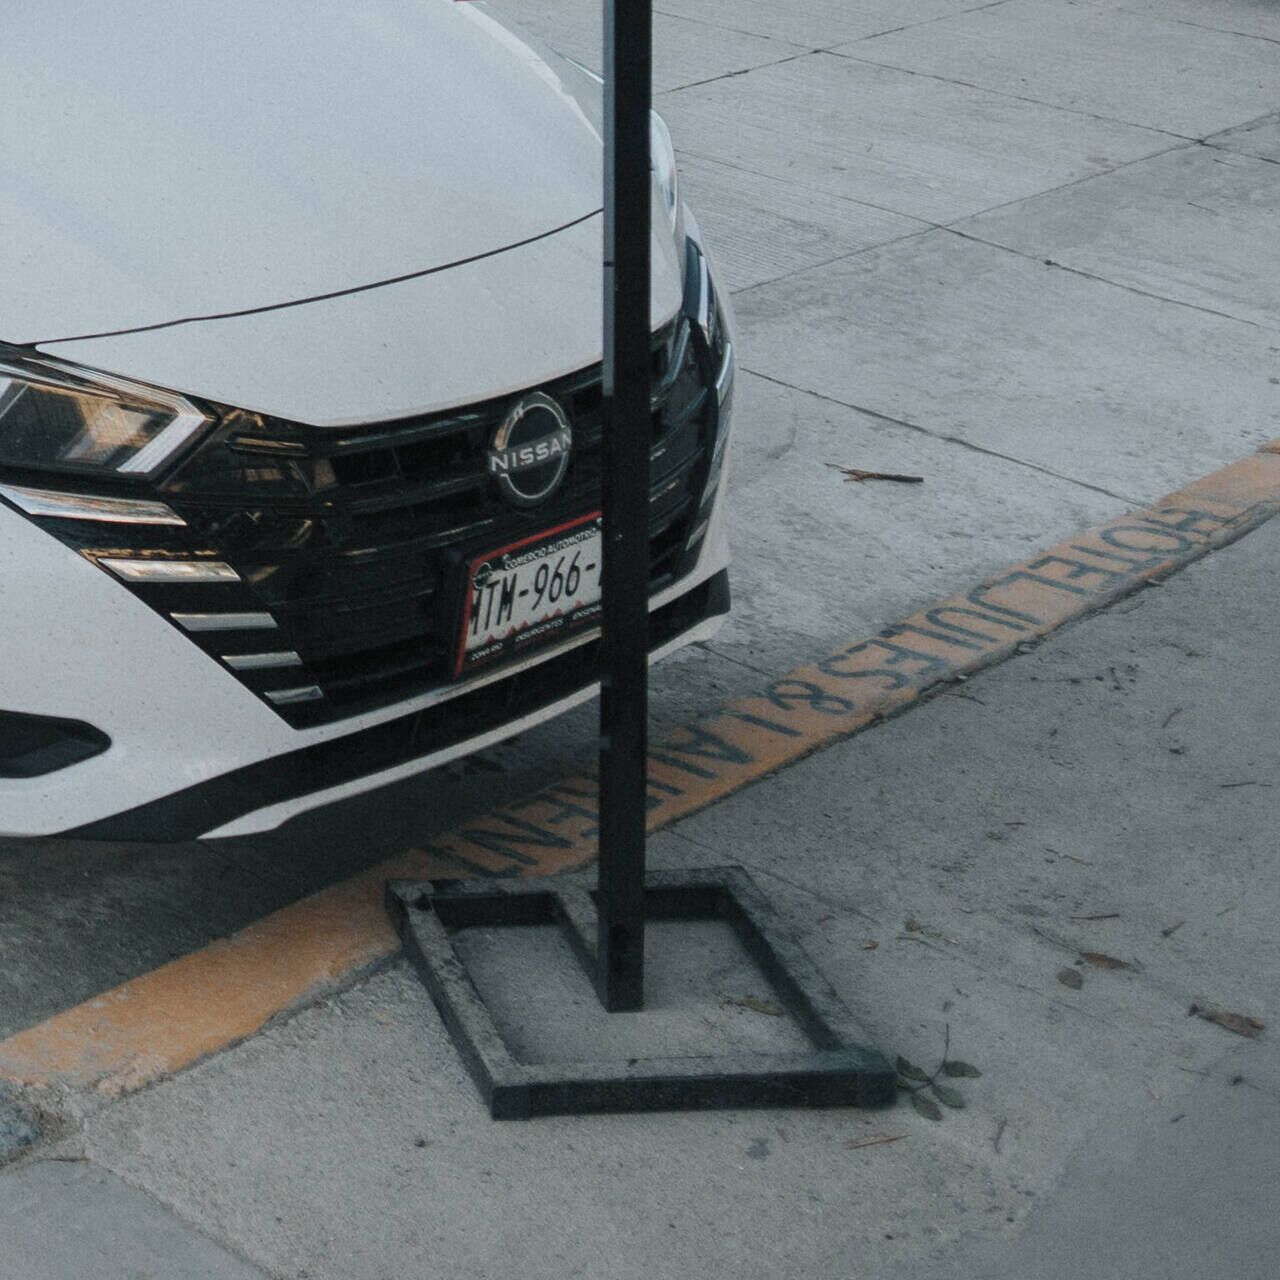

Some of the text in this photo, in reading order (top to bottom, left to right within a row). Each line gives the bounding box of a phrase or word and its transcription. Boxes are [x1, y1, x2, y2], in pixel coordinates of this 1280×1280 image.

[490, 431, 572, 471] NISSAN
[470, 550, 602, 635] TM-966-
[430, 507, 1238, 878] HOTEL JULES & LAUENT
